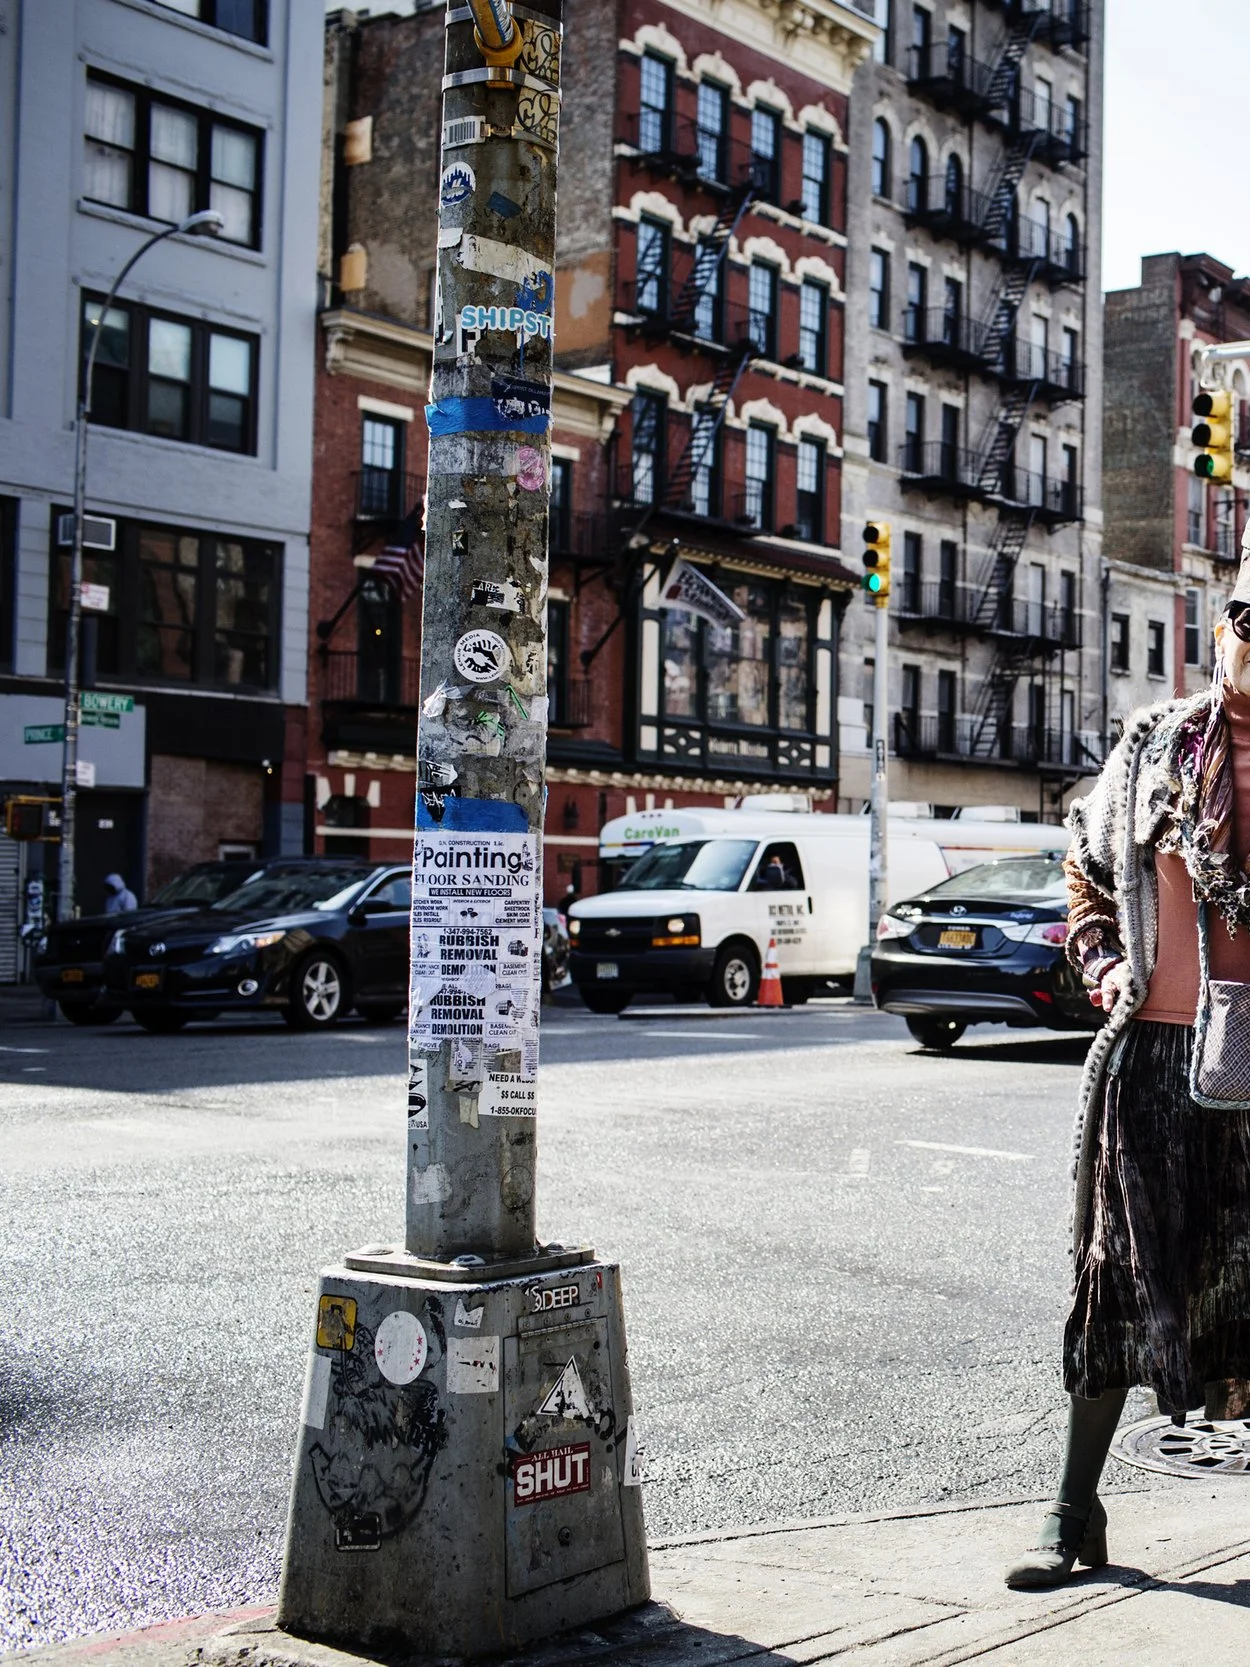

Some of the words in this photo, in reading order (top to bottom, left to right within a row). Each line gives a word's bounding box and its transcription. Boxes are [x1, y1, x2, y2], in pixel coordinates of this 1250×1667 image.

[84, 692, 129, 711] BOWERY
[624, 825, 680, 839] CareVan
[422, 847, 521, 874] Painting
[415, 874, 457, 887] FLOOR
[462, 874, 529, 887] SANDING
[439, 935, 500, 947] RUBBISH
[440, 949, 498, 960] REMOVAL
[431, 1008, 485, 1020] REMOVAL
[432, 1023, 483, 1035] DEMOLITION
[489, 1074, 509, 1082] NEED
[510, 1075, 514, 1083] A
[510, 1091, 526, 1099] CALL
[531, 1452, 549, 1461] ALL
[552, 1446, 573, 1456] HAIL
[516, 1451, 589, 1497] SHUT
